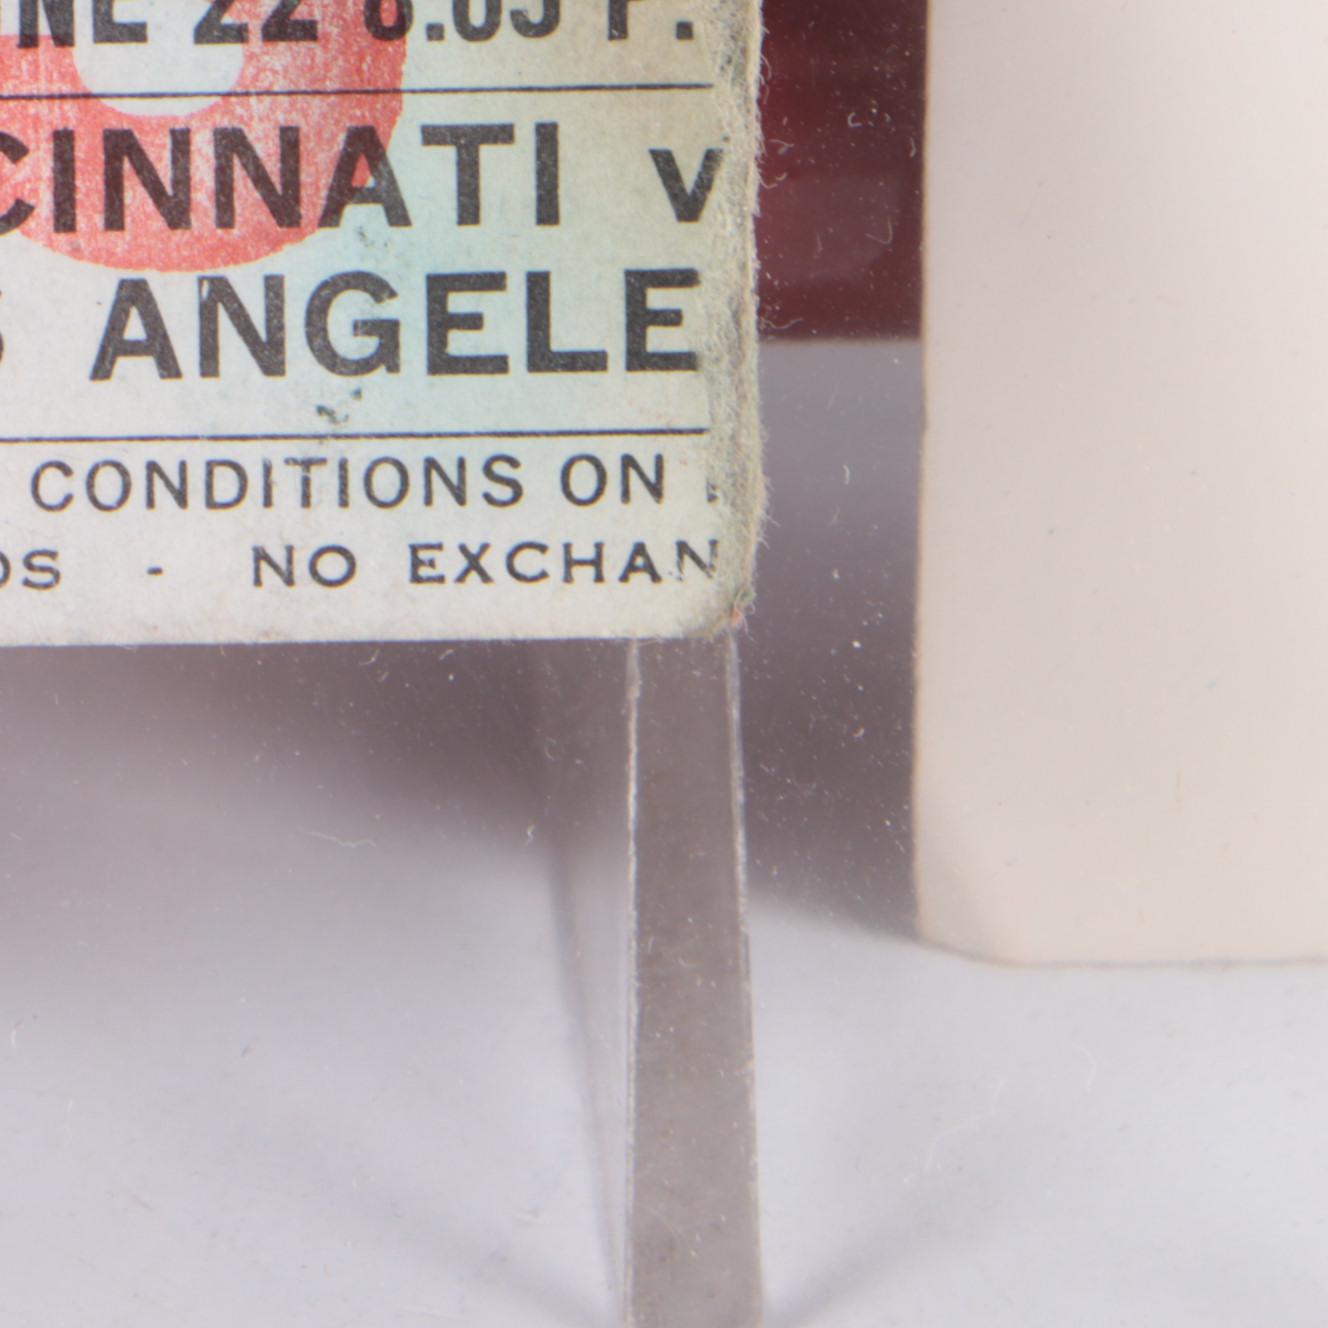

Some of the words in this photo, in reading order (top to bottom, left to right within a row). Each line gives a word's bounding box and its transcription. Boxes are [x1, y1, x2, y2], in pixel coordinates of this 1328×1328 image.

[92, 269, 699, 379] ANGELE
[34, 457, 522, 509] CONDITIONS
[562, 455, 662, 505] ON
[255, 548, 355, 586] NO
